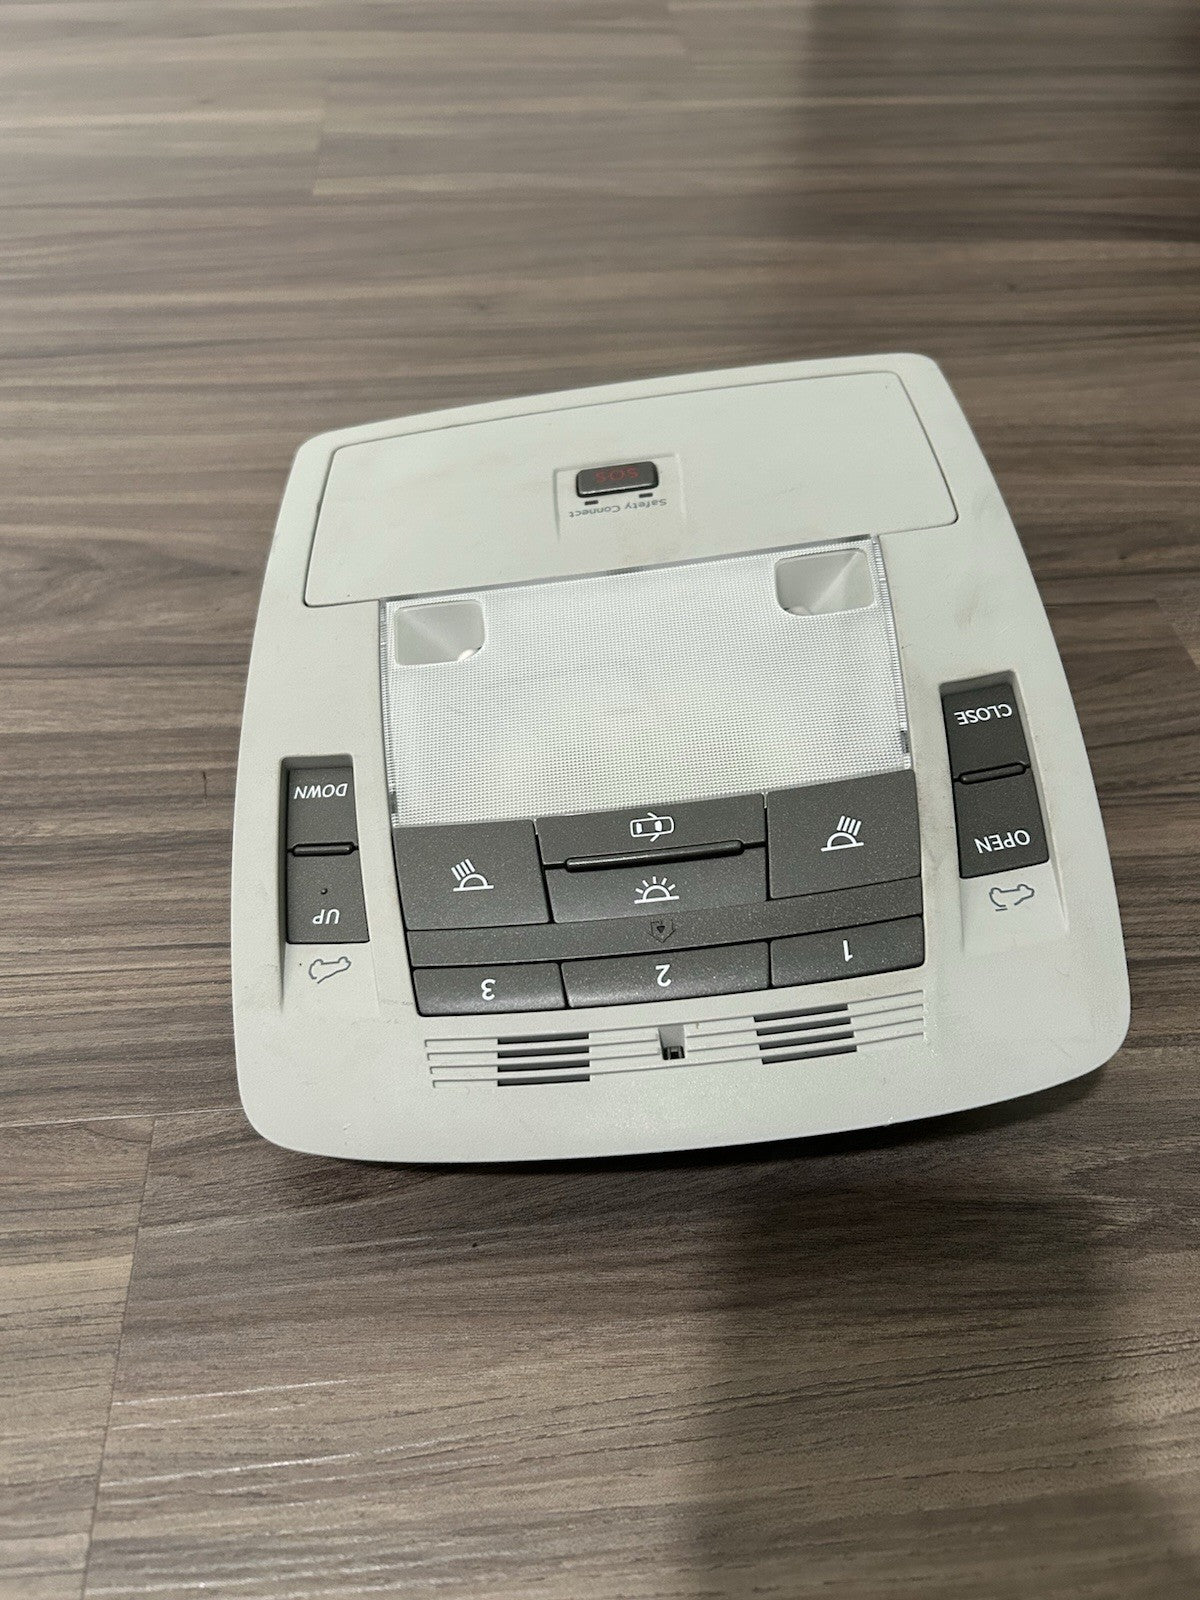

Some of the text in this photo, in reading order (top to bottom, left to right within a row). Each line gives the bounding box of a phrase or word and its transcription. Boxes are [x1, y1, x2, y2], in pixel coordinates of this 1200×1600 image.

[595, 466, 639, 484] SOS
[568, 498, 668, 518] Safety Connect
[954, 703, 1013, 725] CLOSE
[293, 783, 349, 800] DOWN
[974, 829, 1031, 854] OPEN
[312, 908, 340, 925] UP
[842, 939, 853, 962] 1
[655, 963, 671, 988] 2
[480, 978, 496, 1001] 3
